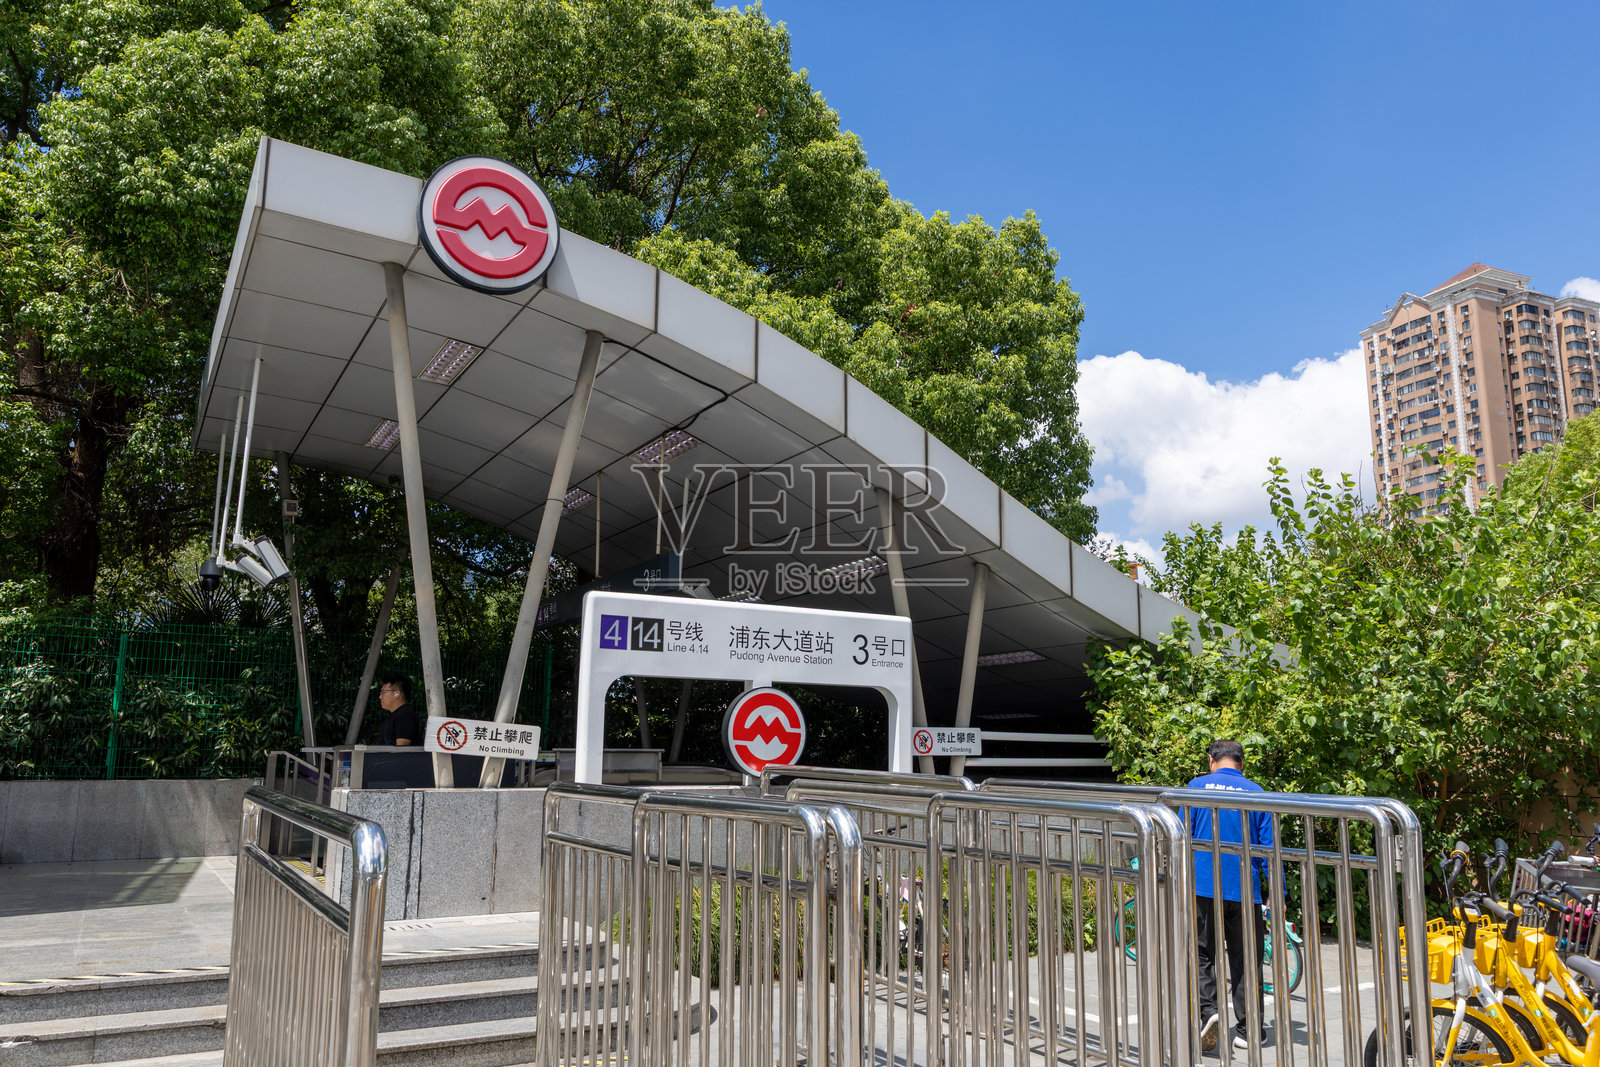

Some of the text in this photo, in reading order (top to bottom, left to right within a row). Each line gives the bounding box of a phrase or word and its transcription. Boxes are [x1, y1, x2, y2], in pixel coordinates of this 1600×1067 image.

[604, 619, 704, 649] 4 14 号线
[729, 625, 834, 655] 浦东大道站
[667, 642, 709, 654] Line 4.14
[730, 650, 833, 665] Pudong Avenue Station
[872, 659, 904, 668] Entrance
[473, 726, 533, 745] 禁止攀爬
[936, 732, 976, 744] 禁止攀爬
[491, 746, 525, 756] Climbing
